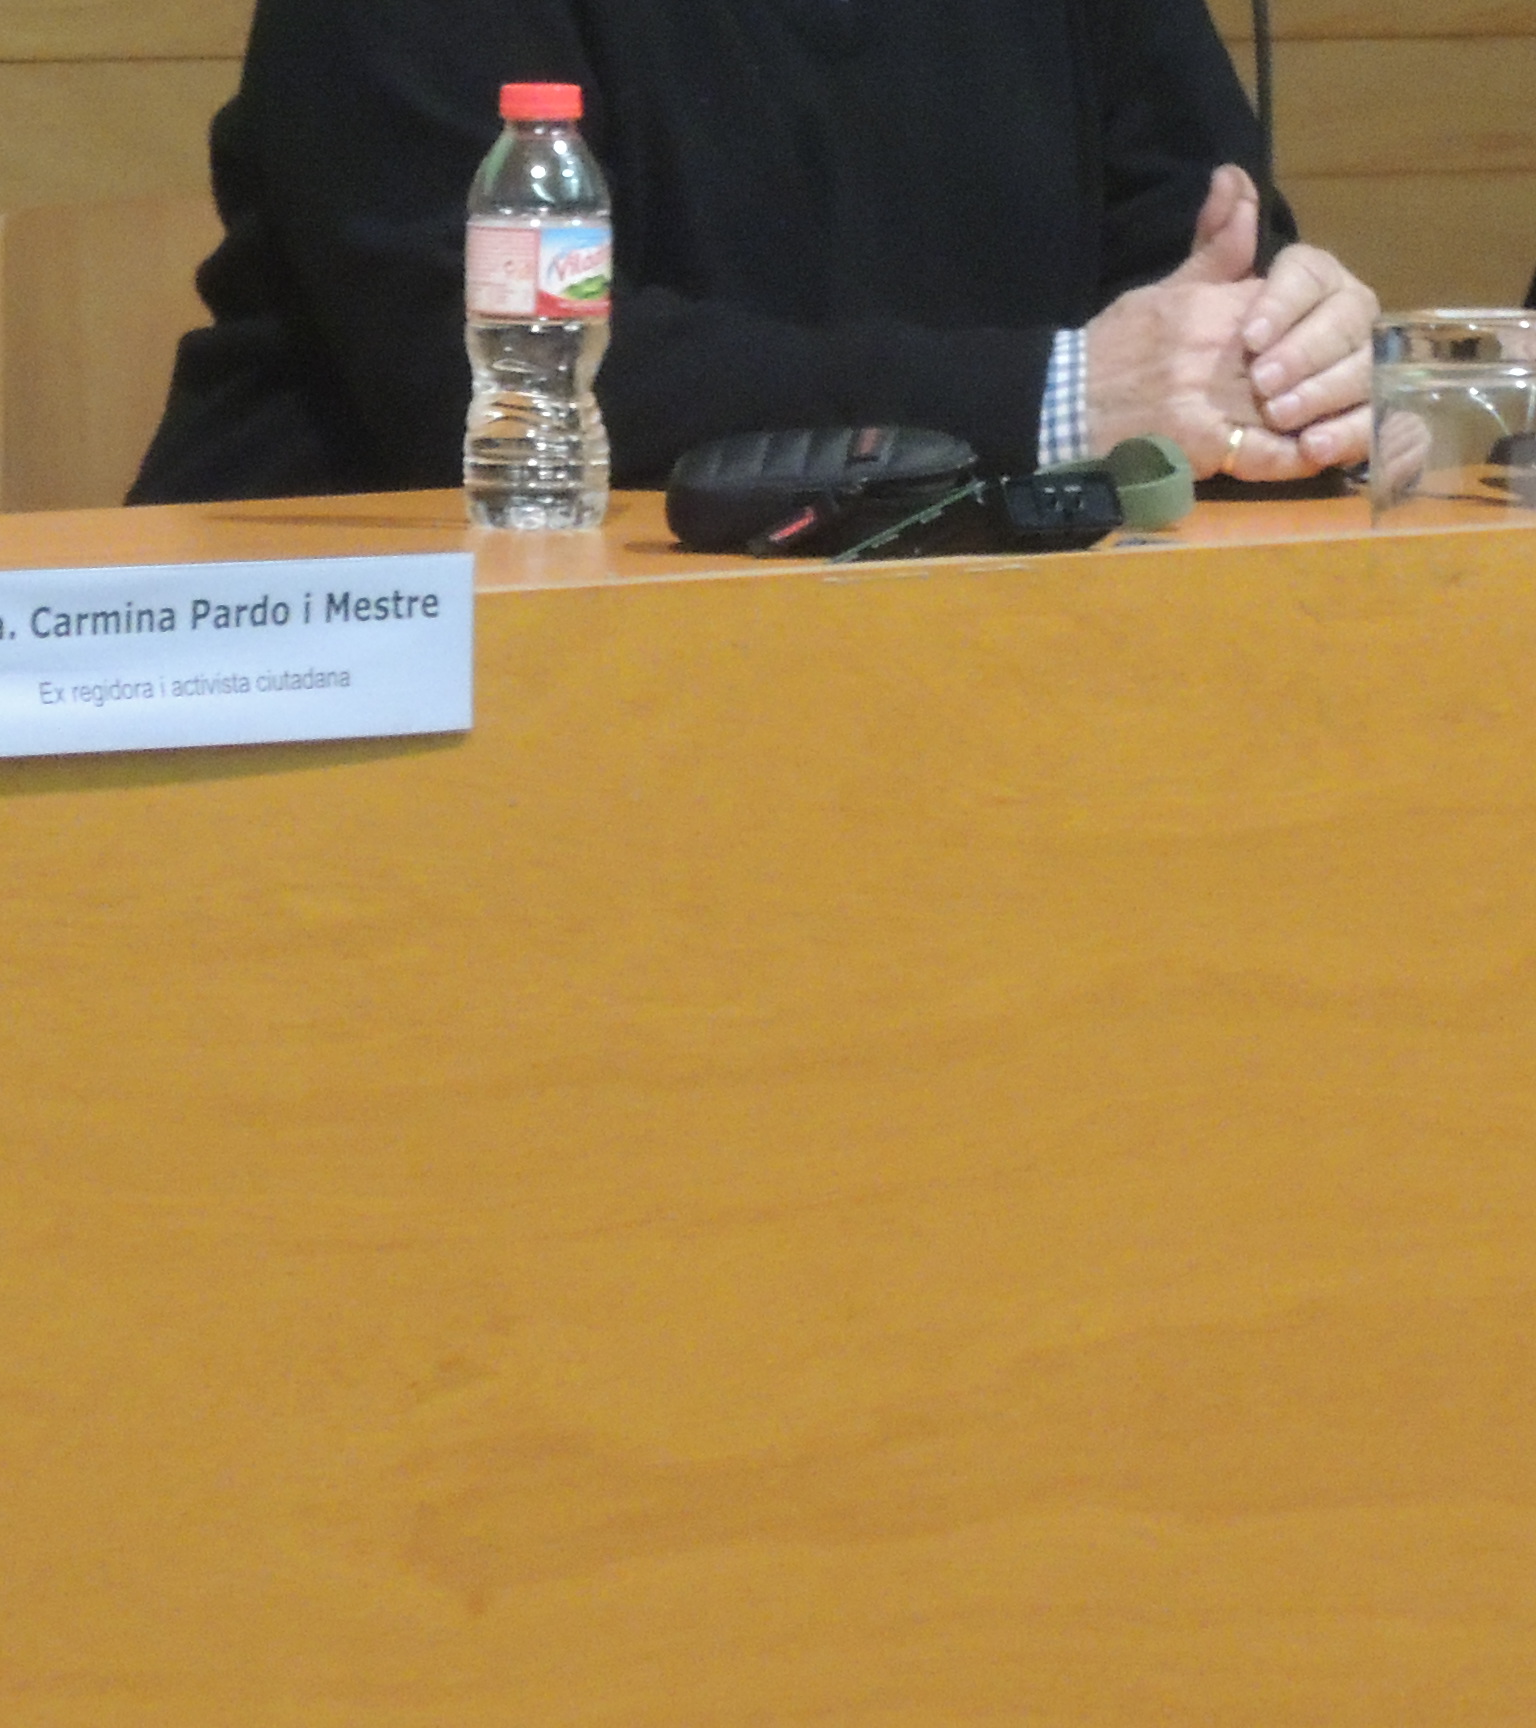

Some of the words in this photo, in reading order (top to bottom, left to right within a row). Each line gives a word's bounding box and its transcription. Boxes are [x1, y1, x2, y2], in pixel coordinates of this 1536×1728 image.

[29, 601, 177, 640] Carmina
[190, 594, 290, 631] Pardo
[303, 593, 311, 625] i
[324, 588, 441, 624] Mestre
[39, 681, 65, 706] Ex
[71, 675, 155, 707] regidora
[170, 669, 251, 698] activista
[255, 666, 351, 694] ciutadana
